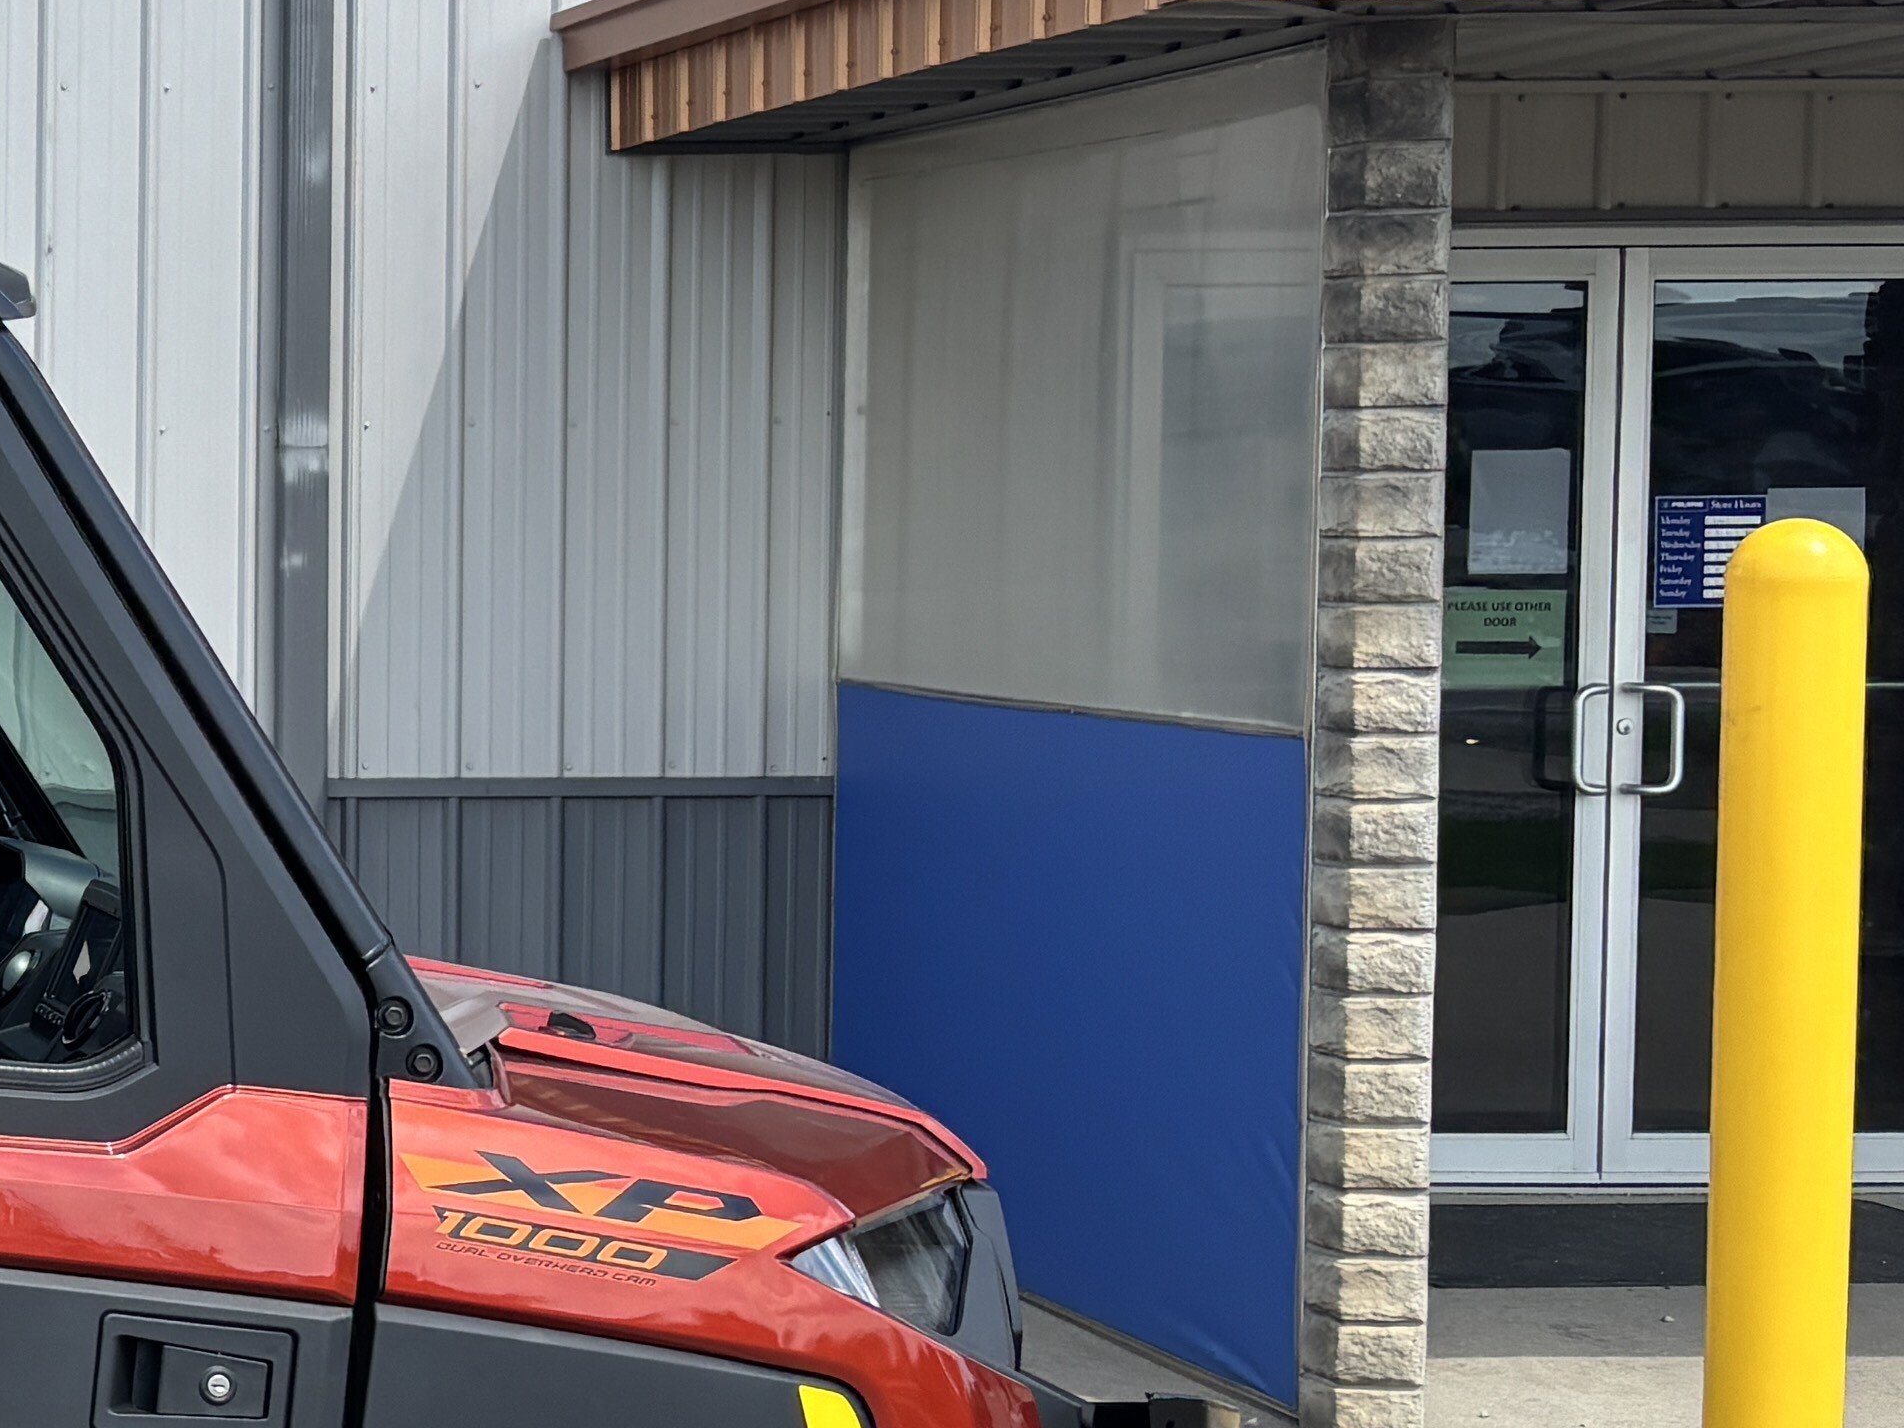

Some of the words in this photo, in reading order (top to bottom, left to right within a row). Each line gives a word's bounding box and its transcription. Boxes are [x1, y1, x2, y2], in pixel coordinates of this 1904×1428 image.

[1447, 601, 1487, 612] PLEASE
[1491, 601, 1512, 612] USE
[1514, 602, 1552, 612] OTHER
[1483, 617, 1517, 627] DOOR
[426, 1150, 763, 1223] XP
[435, 1210, 668, 1271] 1000
[435, 1241, 491, 1259] DUAL
[496, 1251, 608, 1279] OVERHEAD
[611, 1271, 657, 1287] CAM
